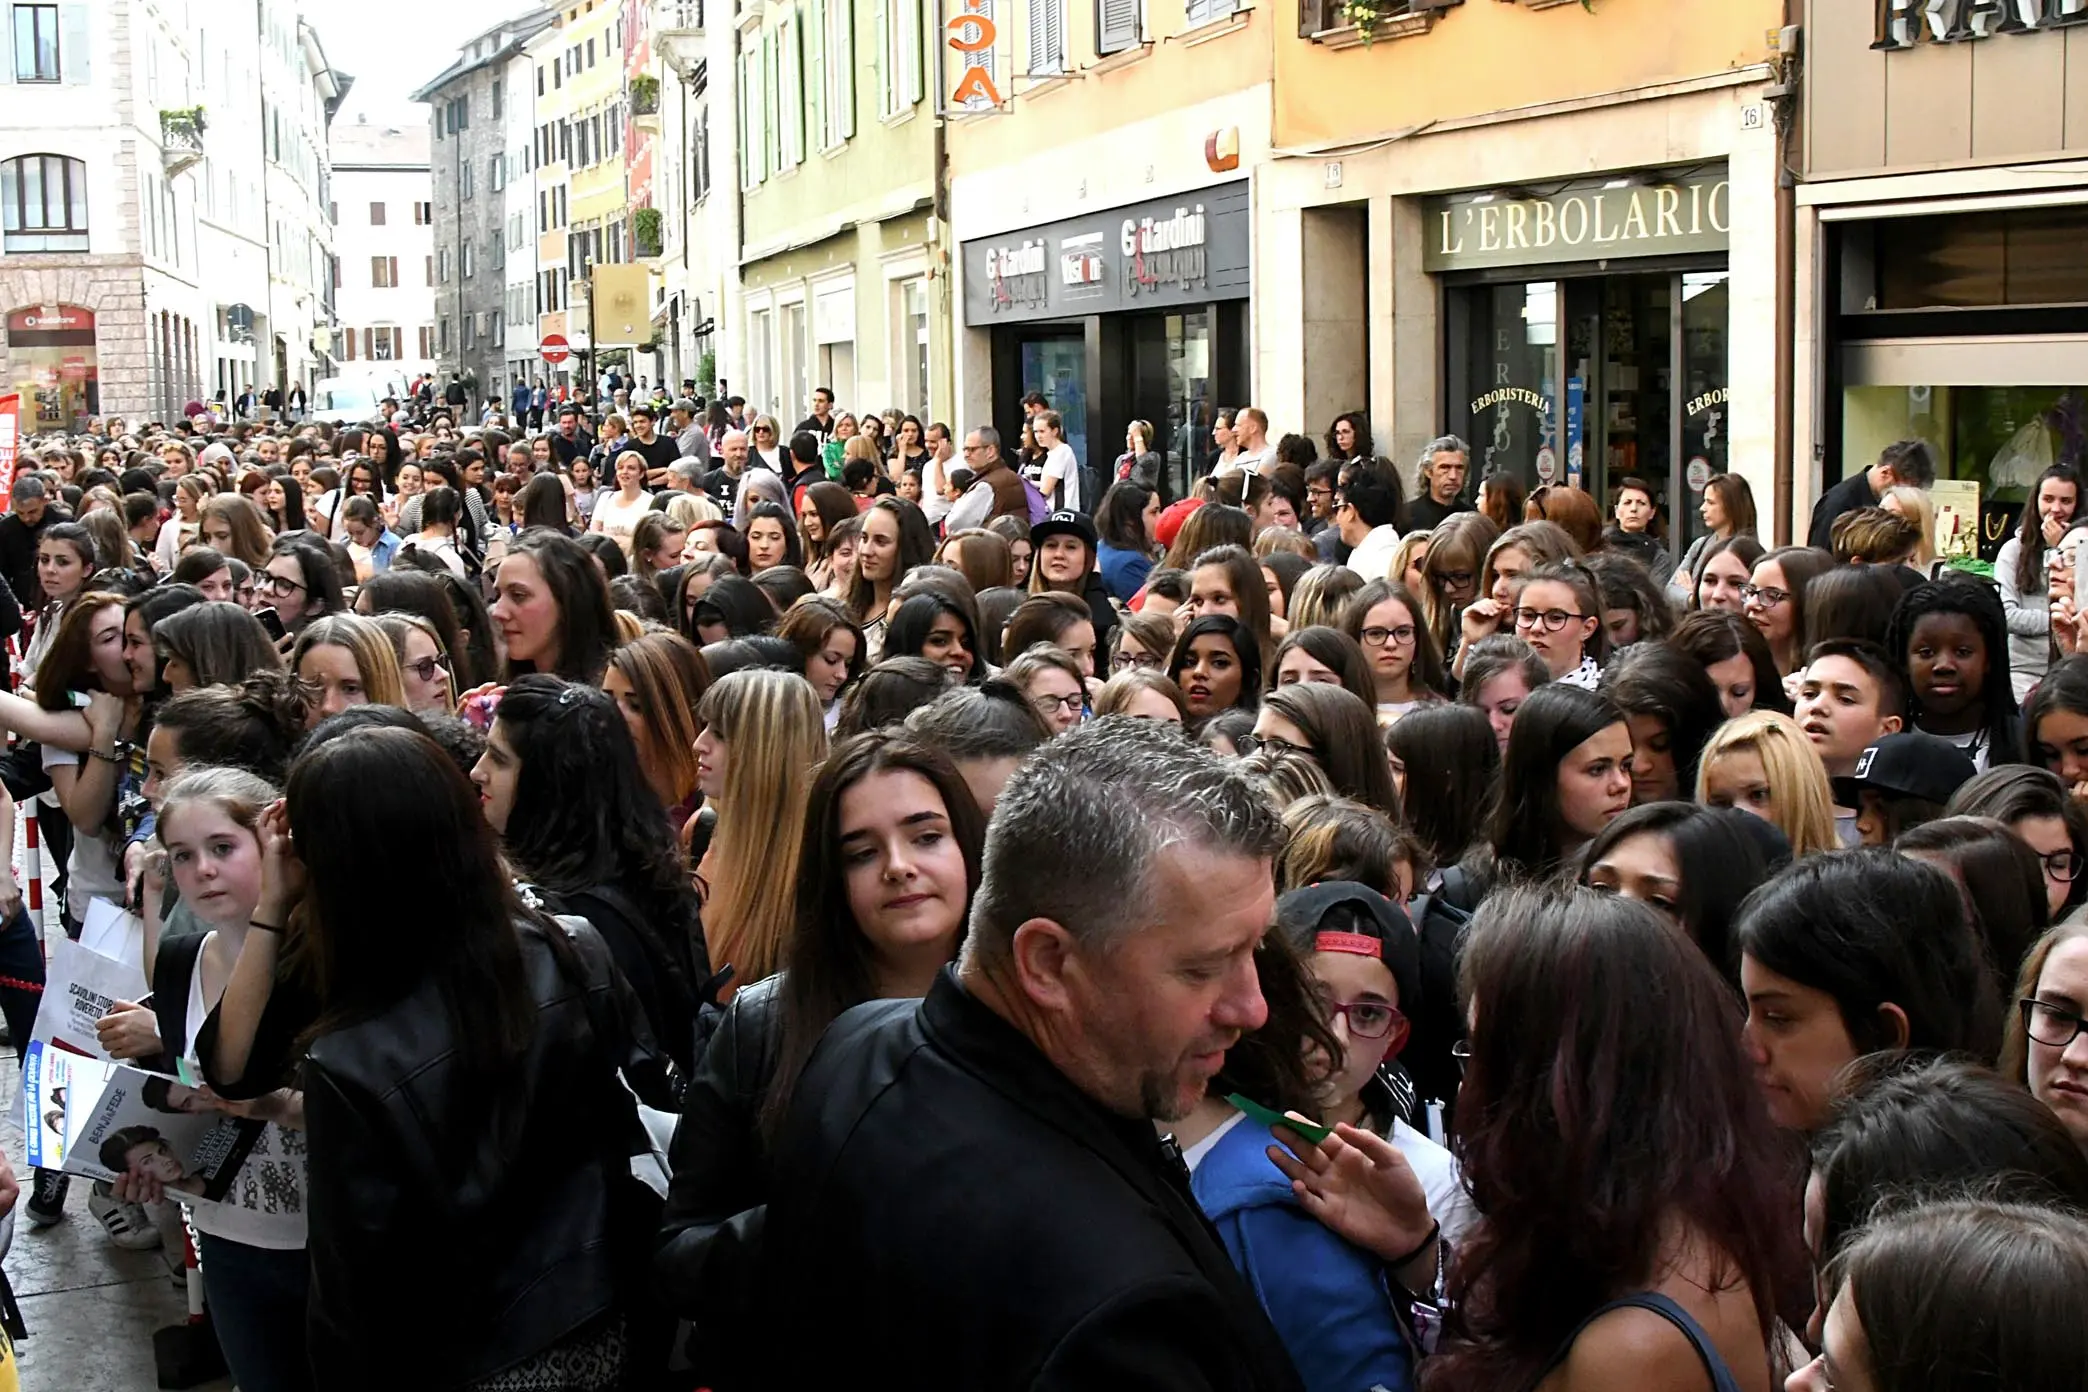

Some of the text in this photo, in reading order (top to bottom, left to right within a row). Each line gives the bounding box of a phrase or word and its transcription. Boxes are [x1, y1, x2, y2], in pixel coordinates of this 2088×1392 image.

[1744, 108, 1757, 126] 16
[1471, 387, 1550, 416] ERBORISTERIA
[69, 982, 98, 1004] SCAVOLINI
[74, 998, 103, 1019] ROVERETO
